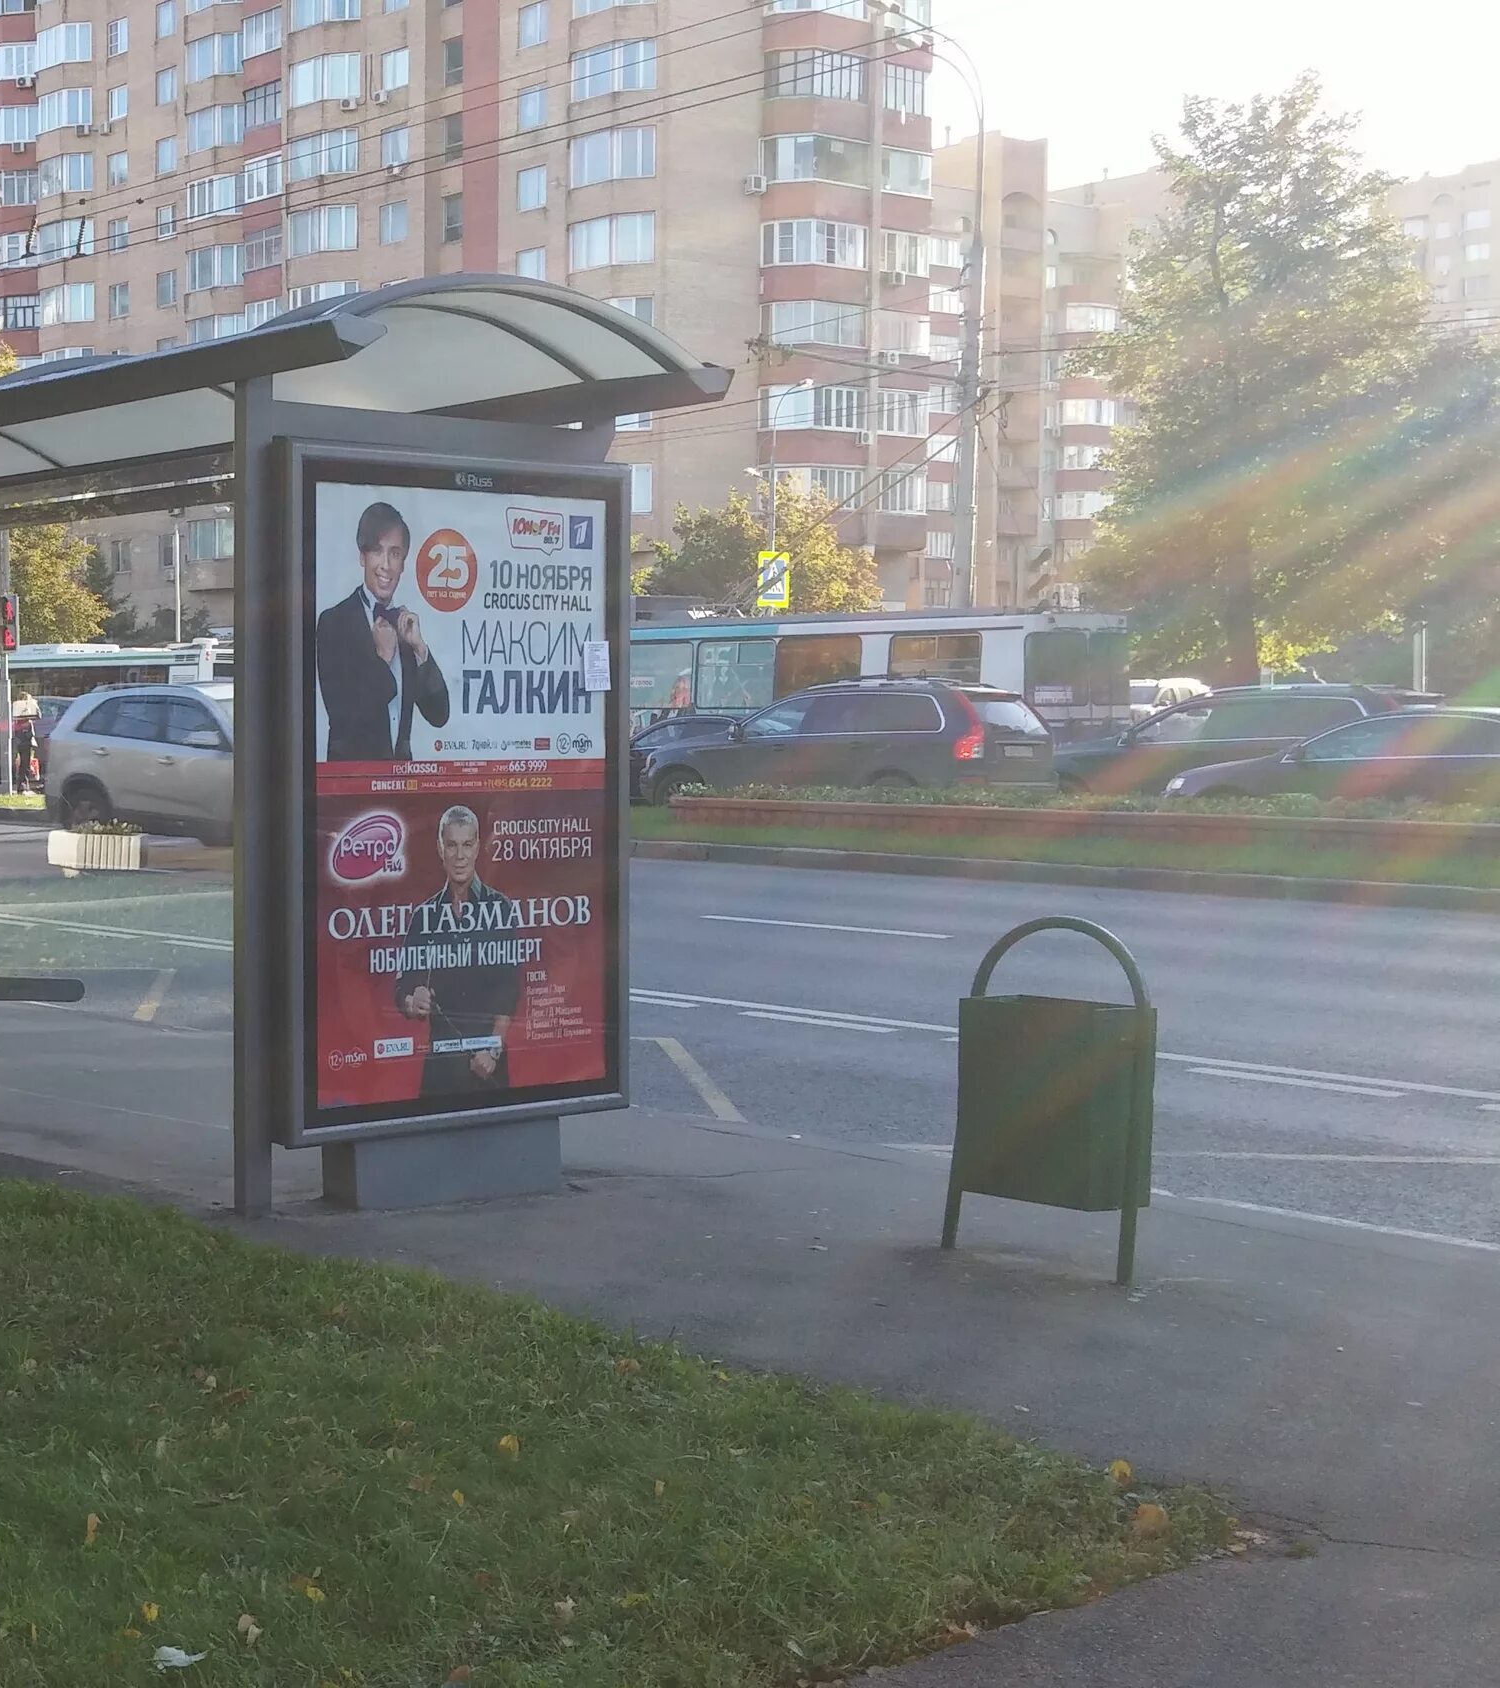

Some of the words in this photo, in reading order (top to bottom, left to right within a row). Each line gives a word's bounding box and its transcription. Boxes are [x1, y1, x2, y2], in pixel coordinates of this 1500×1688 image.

[467, 474, 493, 488] Russ
[428, 543, 469, 590] 25
[489, 560, 512, 590] 10
[516, 563, 592, 592] НОЯБРЯ
[483, 592, 531, 611] CROCUS
[532, 594, 559, 612] CITY
[560, 595, 592, 613] HALL
[462, 619, 592, 666] МАКСИМ
[462, 669, 592, 715] ГАЛКИН
[508, 760, 526, 772] 665
[527, 760, 548, 771] 9999
[508, 778, 528, 788] 644
[530, 777, 553, 788] 2222
[493, 819, 537, 836] CROCUS
[538, 818, 561, 834] CITY
[562, 817, 593, 833] HALL
[340, 835, 397, 862] Ретро
[491, 839, 514, 862] 28
[519, 836, 592, 860] ОКТЯБРЯ
[328, 902, 414, 940] ОЛЕГ
[369, 937, 472, 974] ЮБИЛЕЙНЫЙ
[477, 937, 543, 967] КОНЦЕРТ
